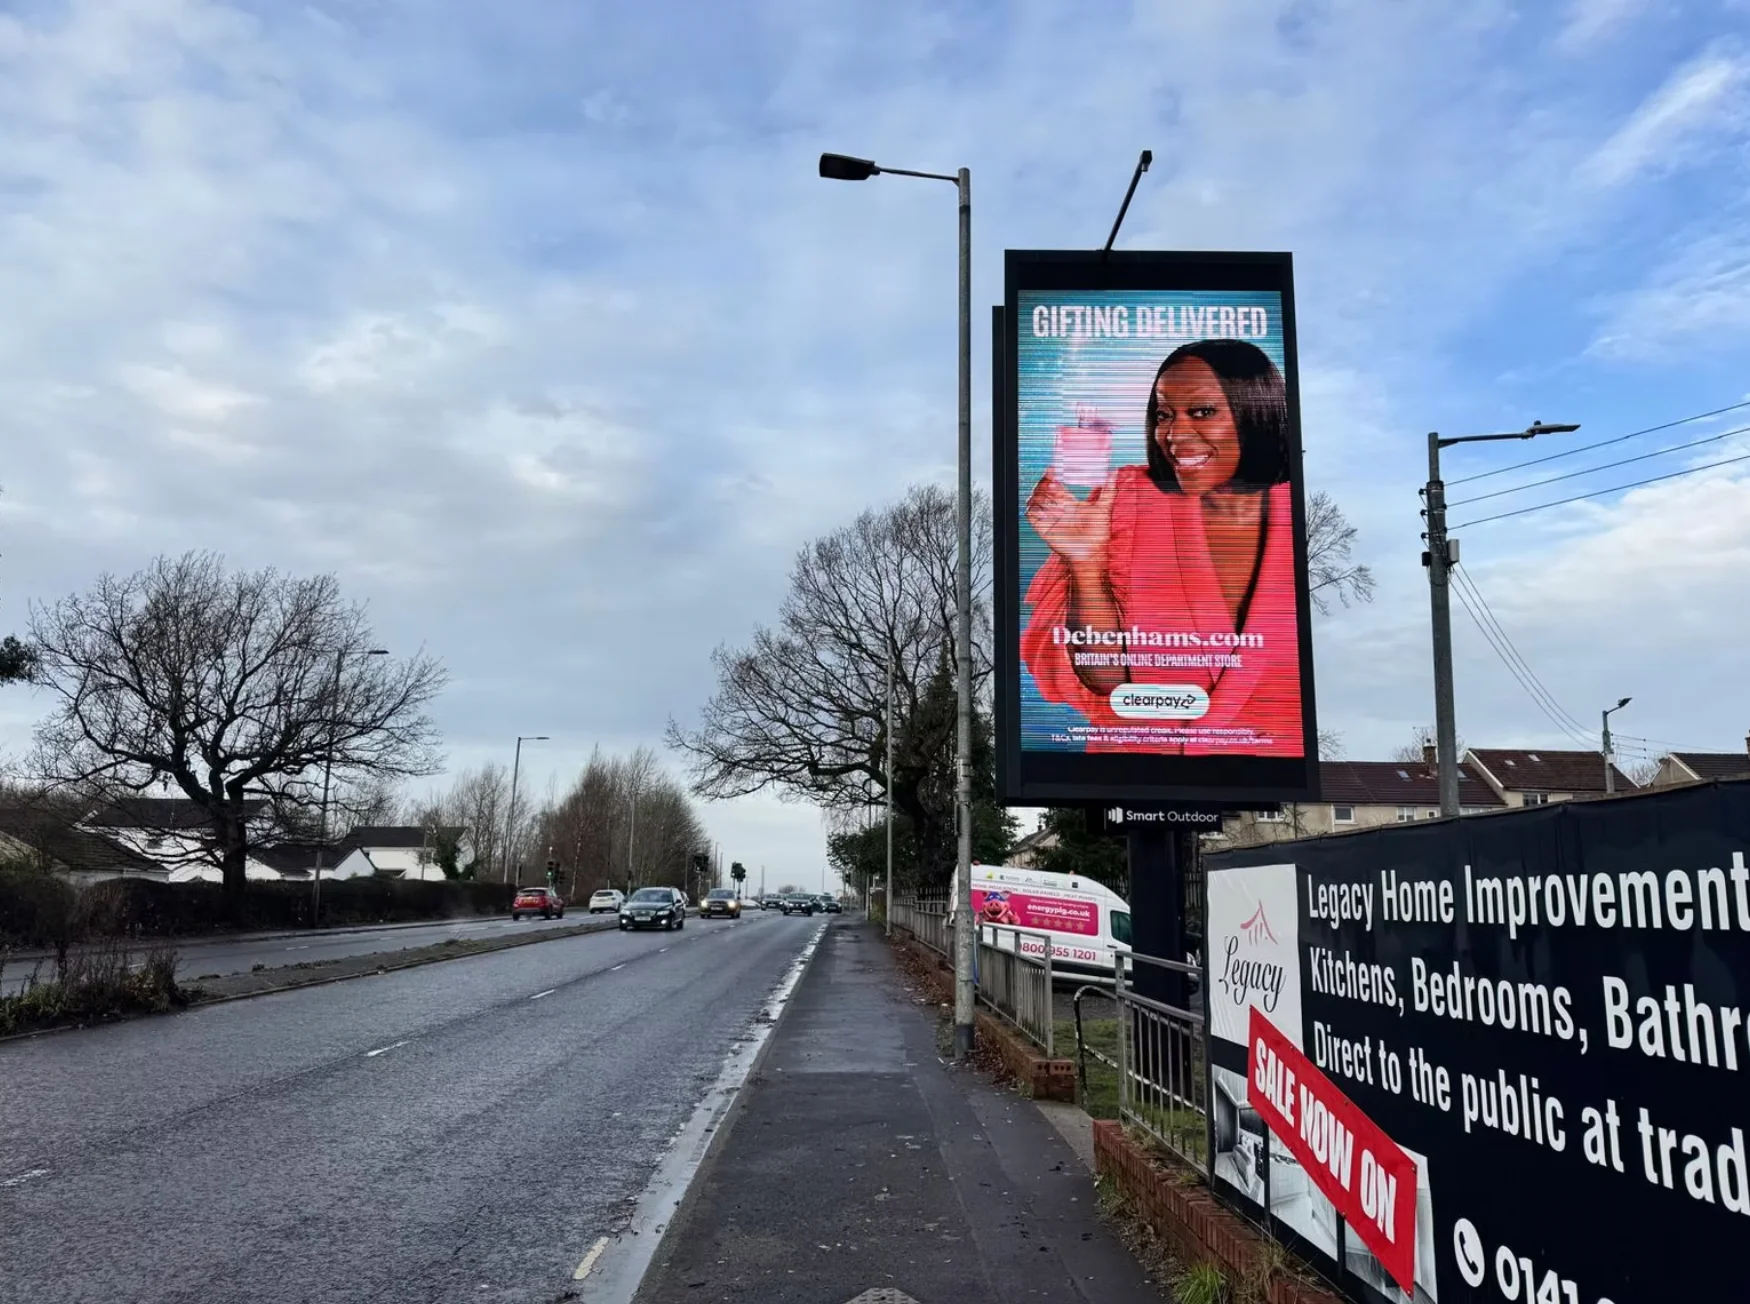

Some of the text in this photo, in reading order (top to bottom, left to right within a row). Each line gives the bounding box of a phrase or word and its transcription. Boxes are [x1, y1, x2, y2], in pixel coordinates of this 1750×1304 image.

[1032, 305, 1268, 338] GIFTING DELIVERED
[1053, 625, 1264, 648] Debenhams.com
[1074, 652, 1243, 668] BRITAIN'S ONLINE DEPARTMENT STORE
[1123, 694, 1181, 709] clearpay
[1126, 810, 1219, 822] Smart Outdoor
[1027, 903, 1091, 918] energypig.co.uk
[1308, 874, 1374, 932] Legacy
[1381, 870, 1455, 924] Home
[1073, 949, 1096, 961] 1201
[1218, 935, 1287, 1013] Legacy
[1309, 946, 1750, 1071] Kitchens, Bedrooms, Bathr
[1314, 1020, 1374, 1085] Direct
[1379, 1033, 1401, 1095] to
[1408, 1048, 1452, 1112] the
[1461, 1069, 1567, 1153] public
[1581, 1099, 1625, 1174] at
[1254, 1037, 1396, 1245] SALE NOW ON
